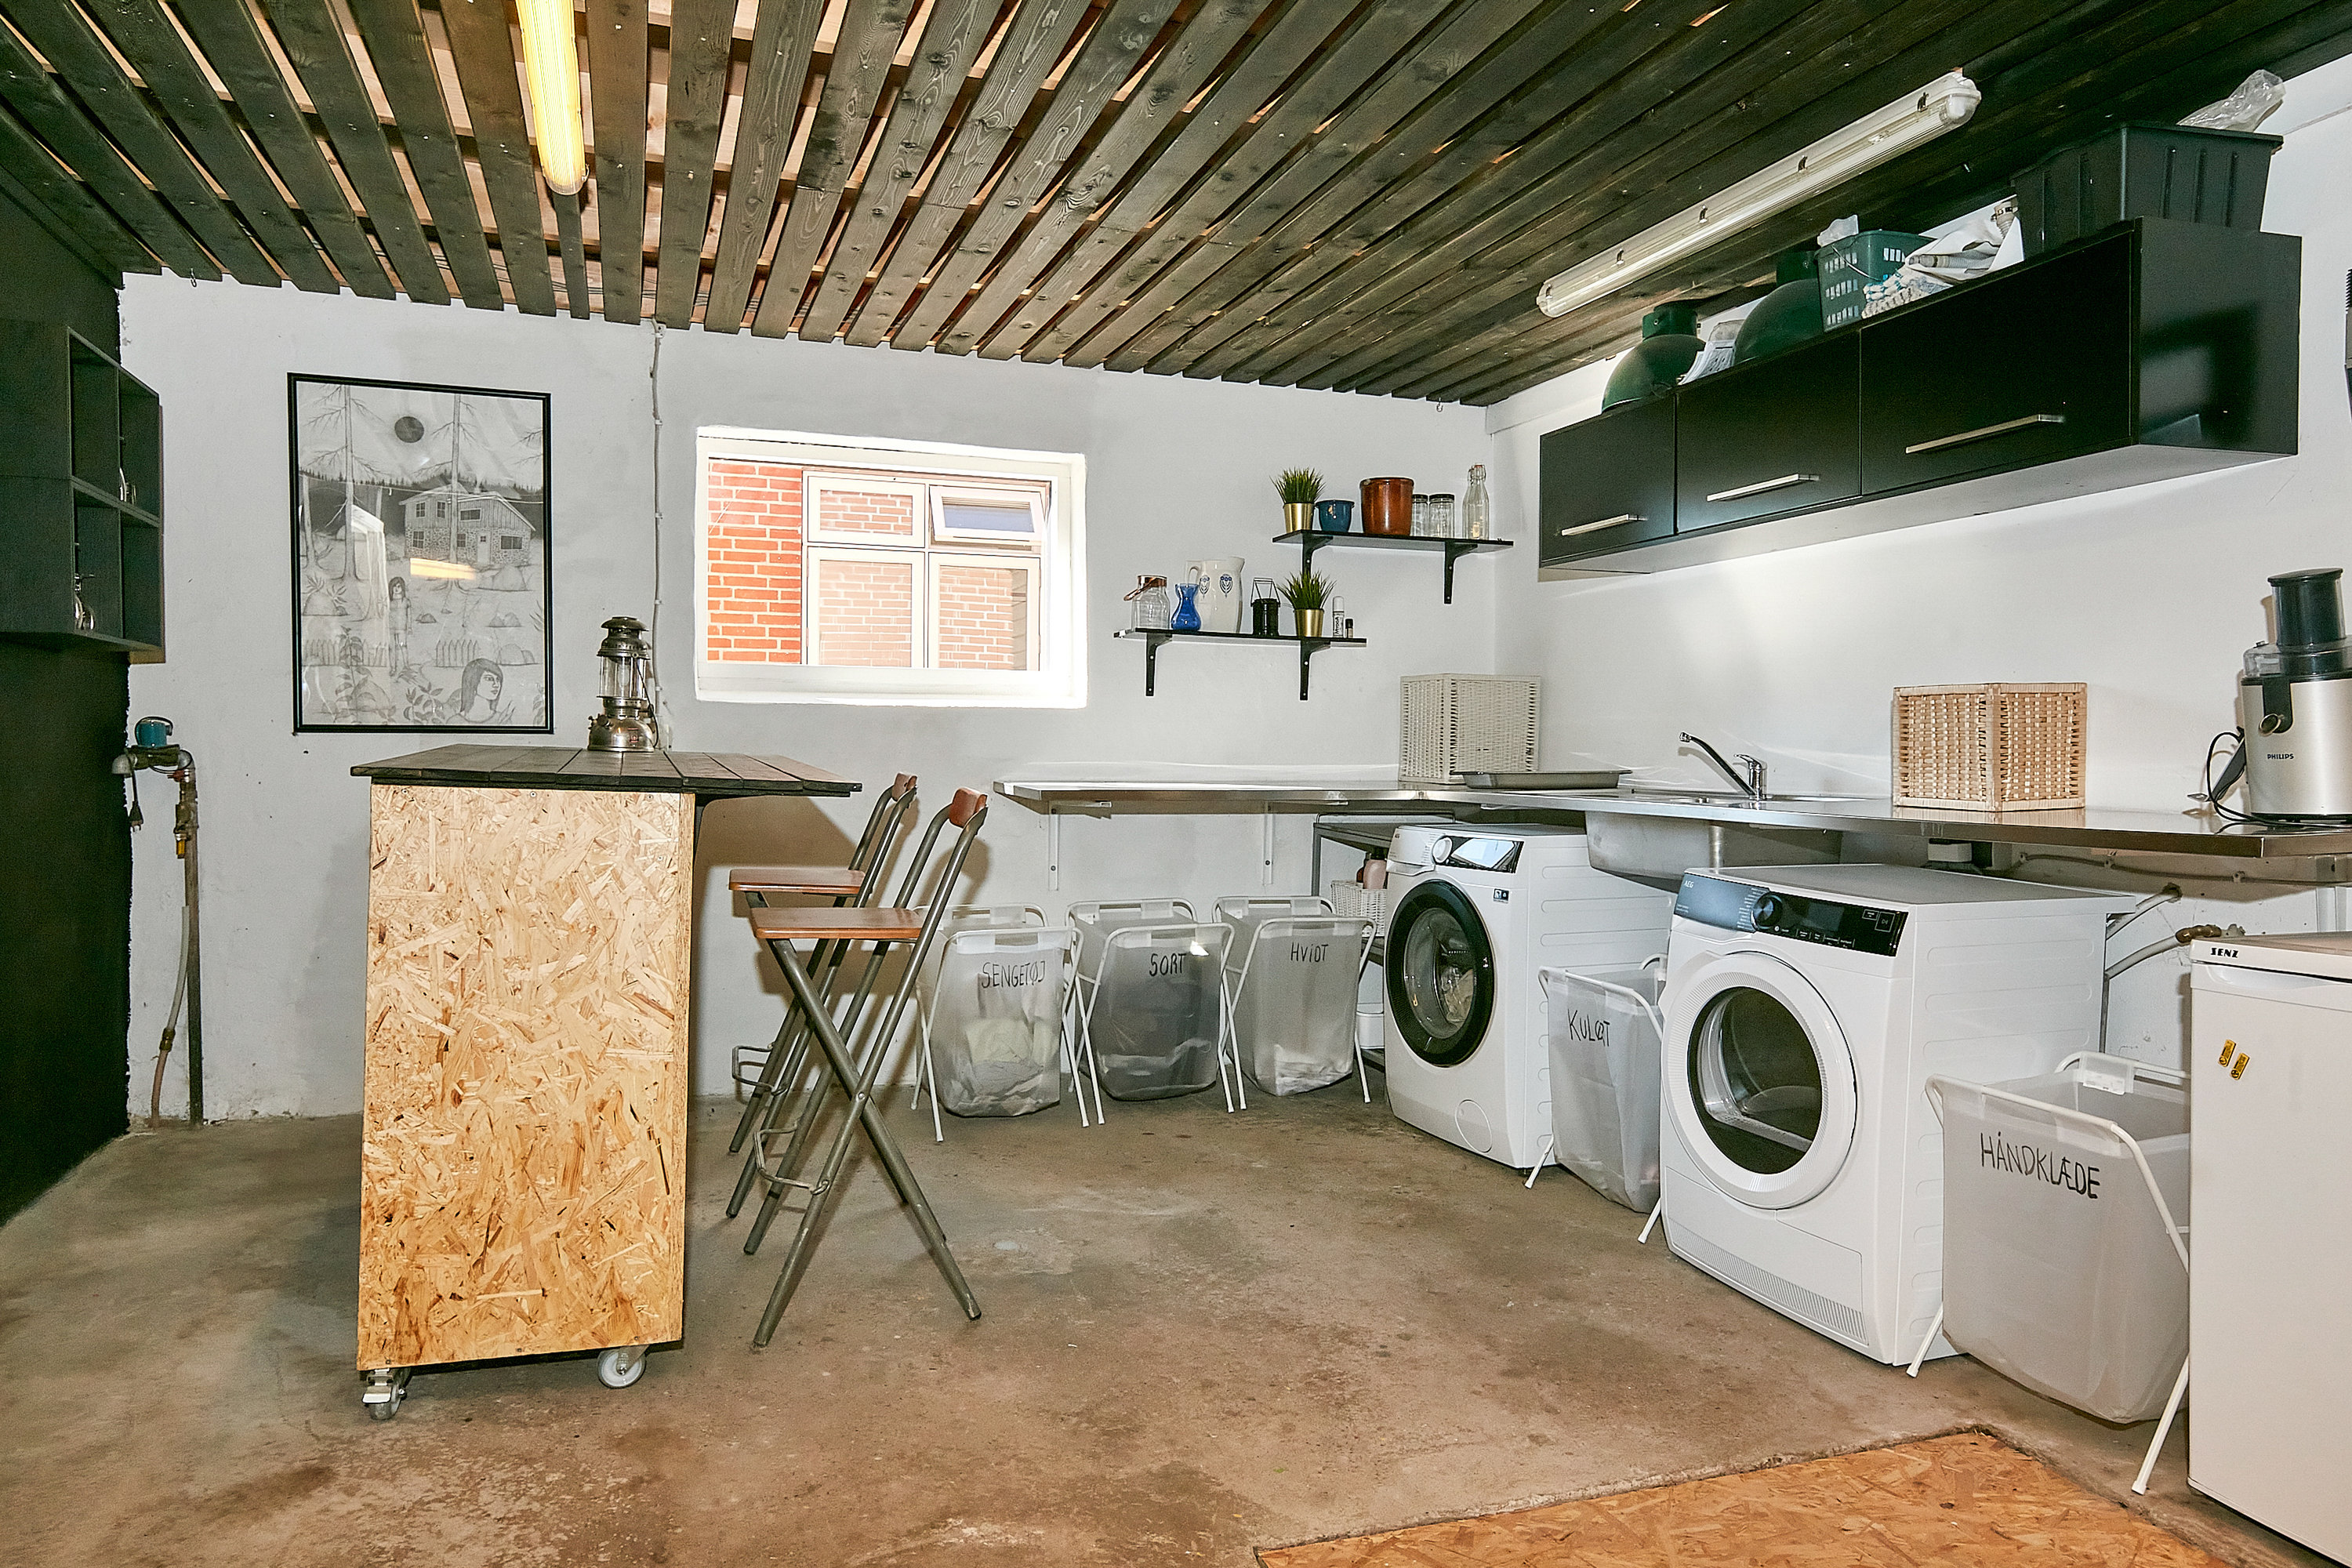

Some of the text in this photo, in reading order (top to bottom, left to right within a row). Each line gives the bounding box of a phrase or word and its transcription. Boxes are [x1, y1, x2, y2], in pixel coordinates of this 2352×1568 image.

[1149, 953, 1187, 977] SORT
[2210, 947, 2239, 959] SENZ
[981, 960, 1046, 989] SENGETØJ
[1980, 1131, 2100, 1200] HÅNDKLÆDE
